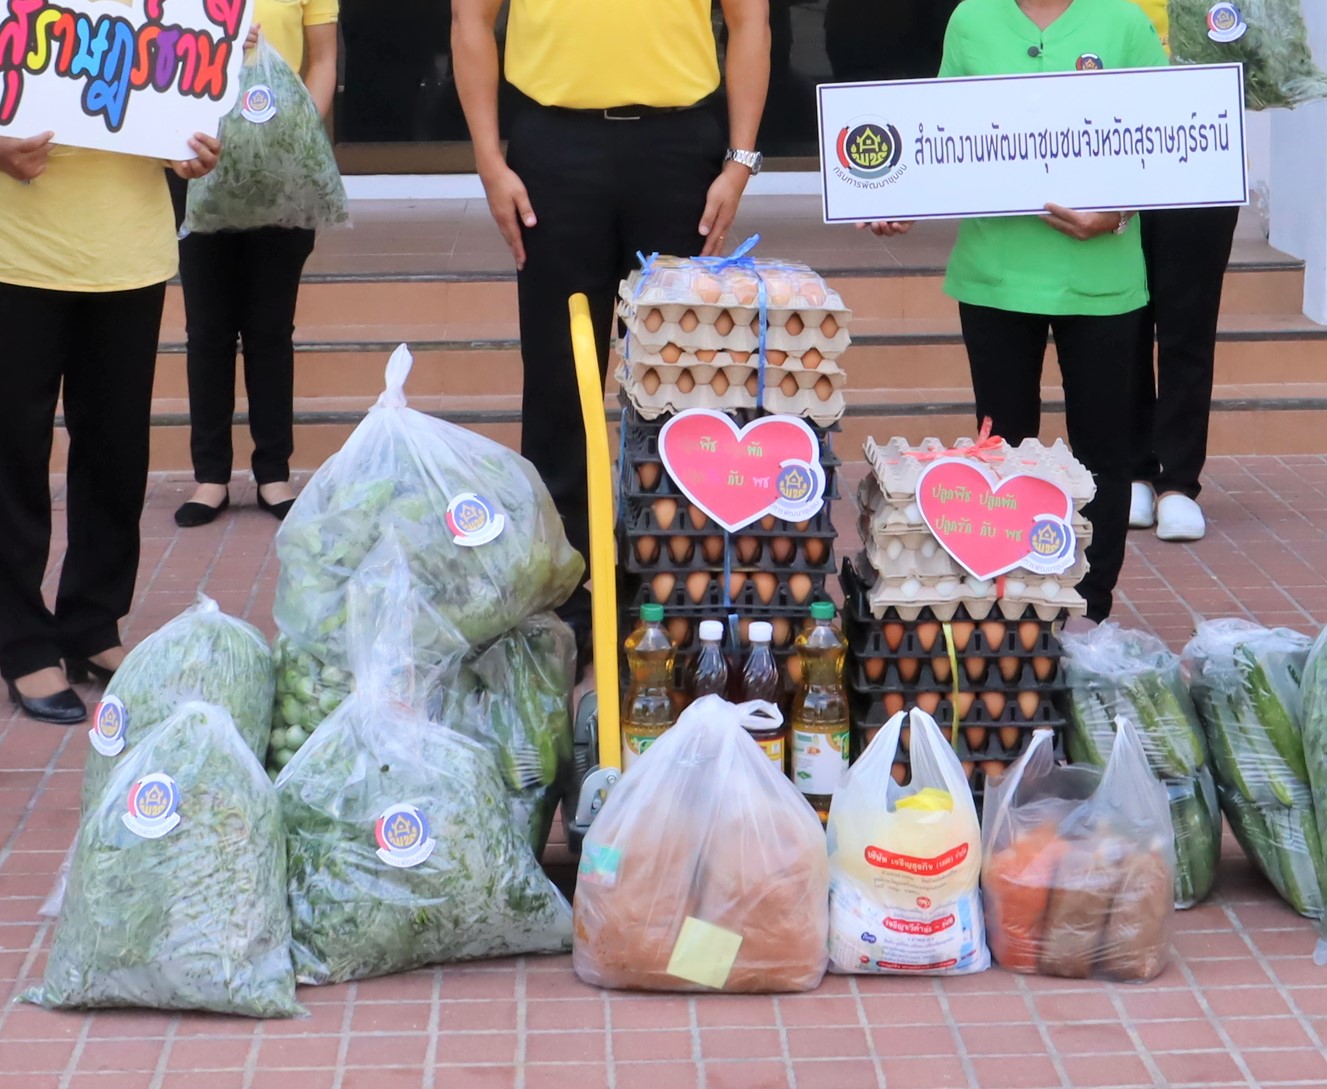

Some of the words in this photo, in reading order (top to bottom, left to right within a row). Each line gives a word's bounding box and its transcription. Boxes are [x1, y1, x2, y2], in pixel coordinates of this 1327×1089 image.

[914, 110, 1230, 173] สำนักงานพัฒนาชุมชนจังหวัดสุราษฎร์ธานี
[832, 162, 908, 190] กรมการพัฒนาชุมชน
